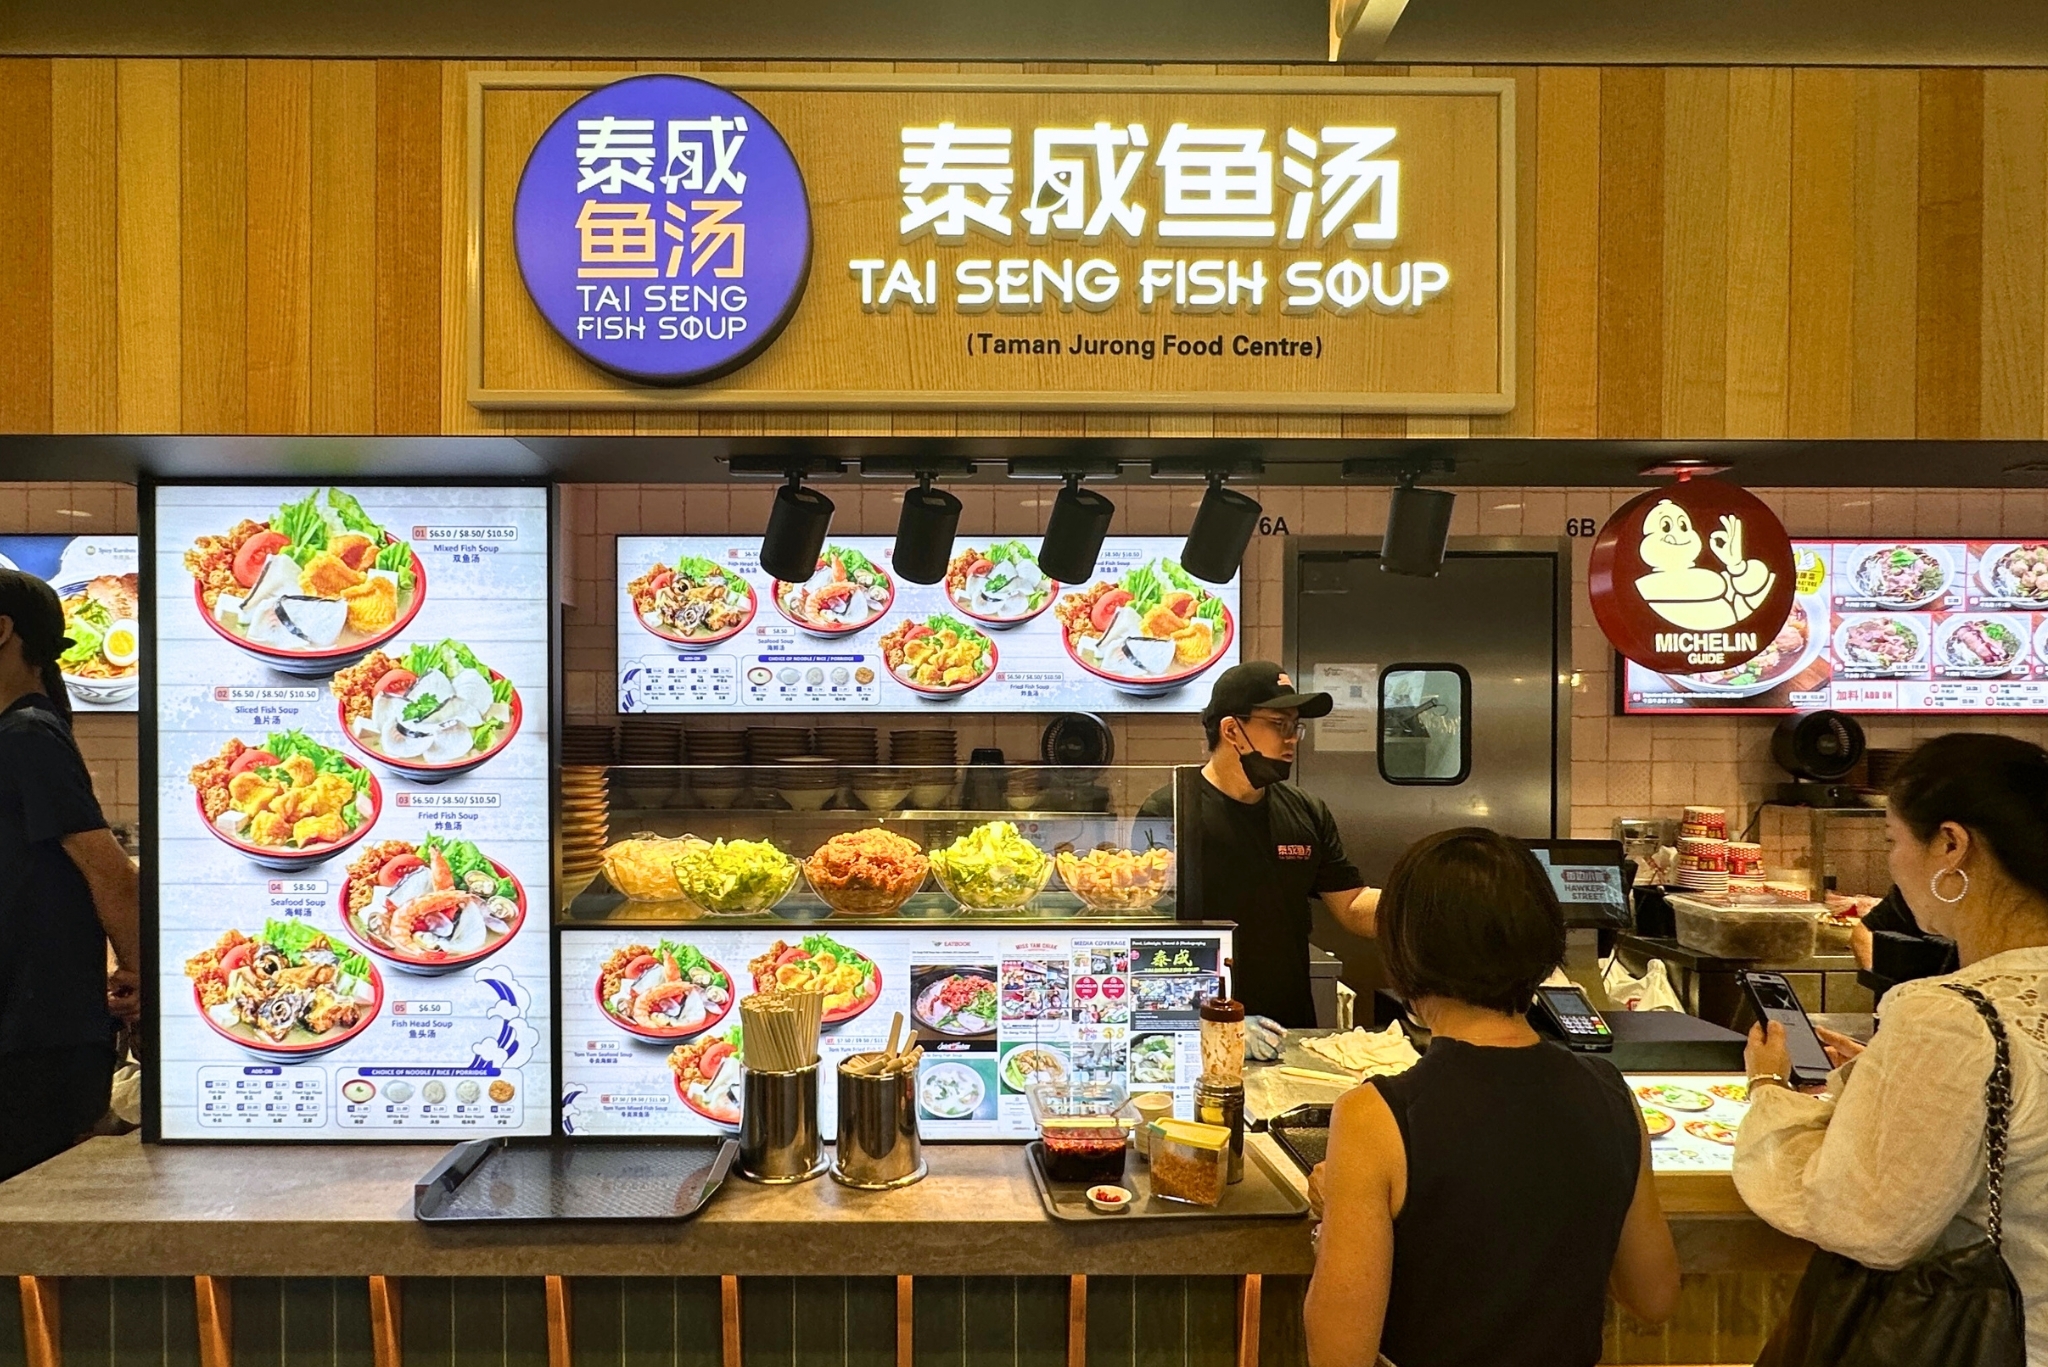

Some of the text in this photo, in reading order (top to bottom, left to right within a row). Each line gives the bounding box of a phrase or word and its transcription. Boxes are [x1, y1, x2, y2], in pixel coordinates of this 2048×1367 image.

[575, 200, 744, 277] 鱼汤
[849, 258, 1450, 307] TAI SENG FISH SOUP
[576, 285, 747, 312] TAI SENG
[577, 315, 747, 340] FISH SOUP
[967, 332, 1324, 359] (Taman Jurong Food Centre)
[1259, 517, 1289, 535] 6A
[1566, 518, 1595, 537] 6B
[415, 530, 425, 538] 01
[429, 529, 451, 538] $6.50
[487, 529, 514, 538] $10.50
[433, 544, 499, 554] Mixed Fish Soup
[453, 554, 480, 563] 双鱼汤
[1655, 632, 1757, 653] MICHELIN
[1687, 653, 1725, 665] GUIDE
[232, 690, 254, 698] $6.50
[290, 690, 316, 698] $10.50
[1836, 689, 1859, 701] 加料
[1864, 691, 1893, 700] ADD ON
[235, 706, 299, 715] Sliced Fish Soup
[253, 715, 281, 725] 鱼片汤
[412, 796, 434, 804] $6.50
[470, 796, 496, 804] $10.50
[458, 812, 478, 821] Soup
[435, 821, 462, 831] 炸鱼汤
[271, 883, 316, 891] 04 $8.50
[271, 898, 326, 907] Seafood Soup
[285, 908, 312, 917] 海鲜汤
[395, 1004, 441, 1012] 05 $6.50
[432, 1020, 453, 1029] Soup
[409, 1029, 436, 1039] 鱼头汤
